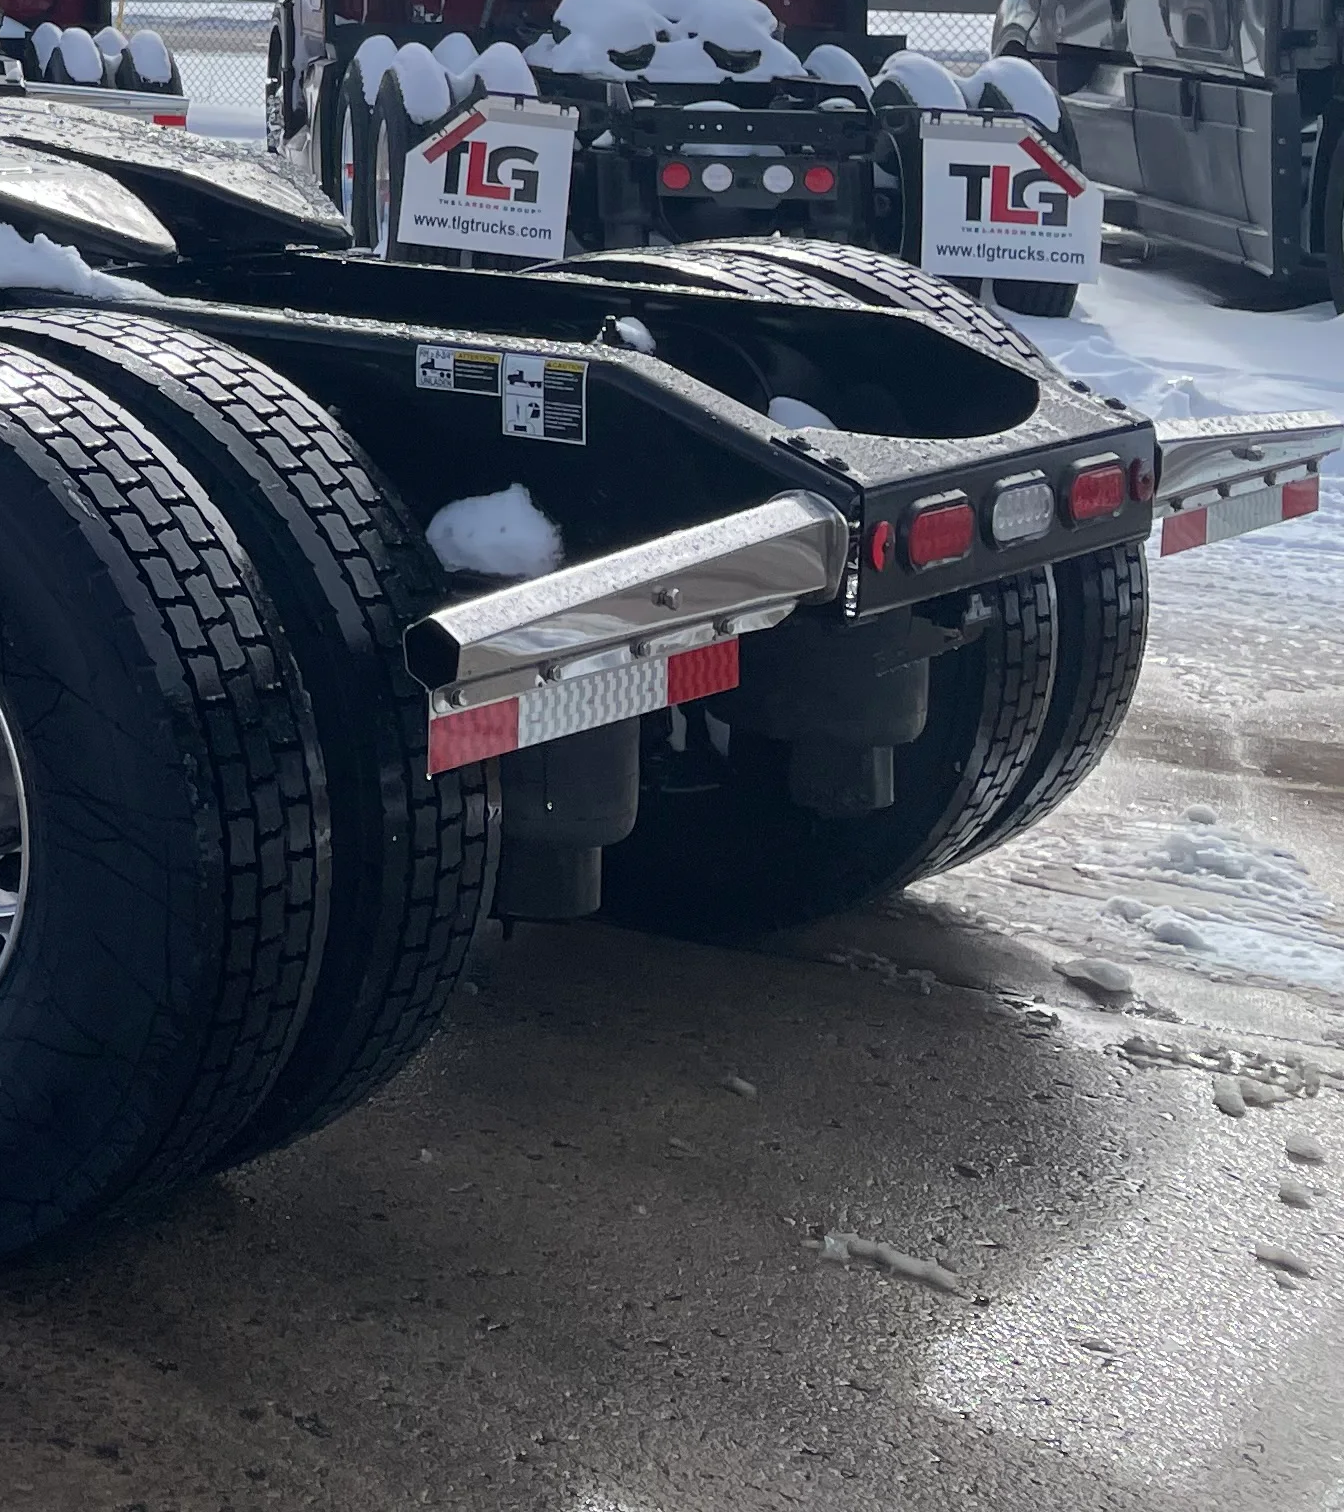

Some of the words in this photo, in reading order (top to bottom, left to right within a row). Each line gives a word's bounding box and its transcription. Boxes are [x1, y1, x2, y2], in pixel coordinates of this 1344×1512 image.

[443, 140, 540, 204] TLG
[948, 163, 1069, 227] TLG
[438, 198, 456, 207] THE
[458, 200, 500, 211] LARSON
[413, 213, 552, 240] www.tlgtrucks.com
[961, 226, 980, 234] THE
[982, 227, 1027, 236] LARSON
[936, 242, 1085, 265] www.tlgtrucks.com
[458, 353, 495, 362] ATTENTION
[552, 362, 584, 371] CAUTION
